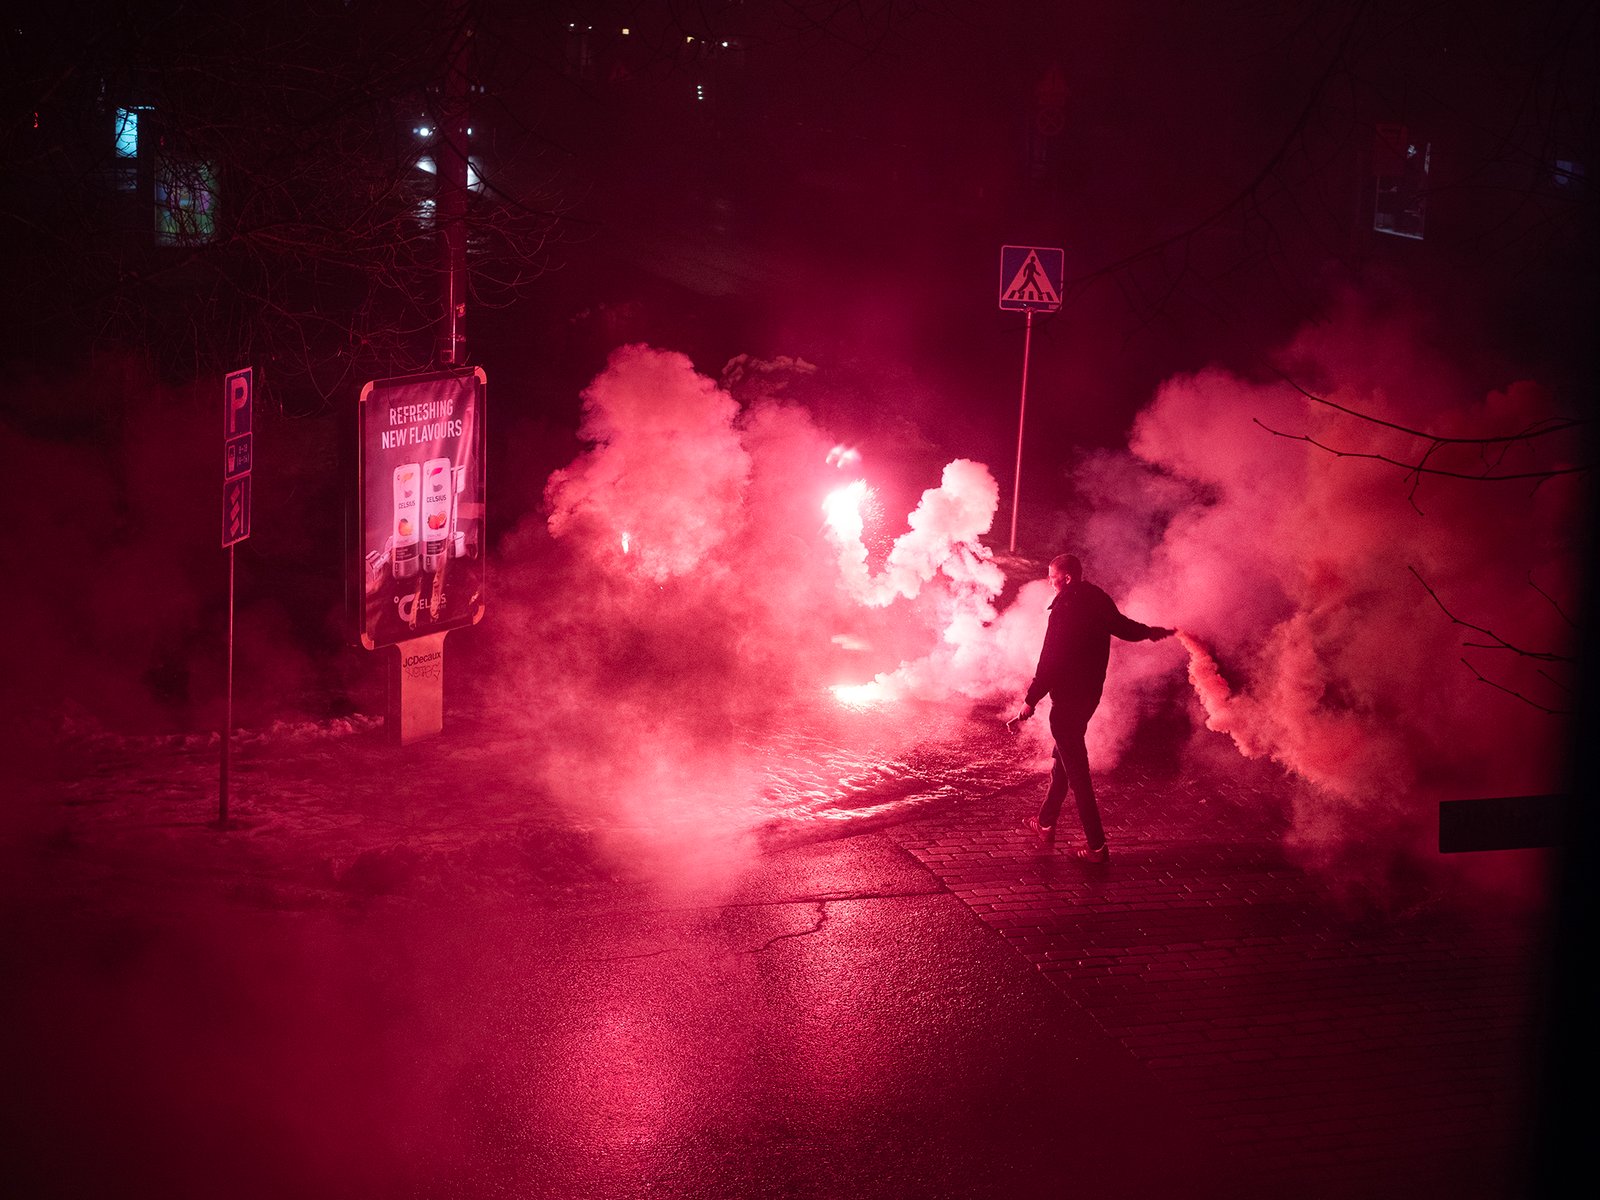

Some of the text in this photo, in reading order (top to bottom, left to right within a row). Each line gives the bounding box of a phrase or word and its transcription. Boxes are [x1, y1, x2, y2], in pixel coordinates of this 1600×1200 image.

[230, 377, 248, 433] P
[390, 399, 453, 426] REFRESHING
[381, 419, 462, 449] NEW FLAVOURS
[398, 500, 416, 509] CELSIUS
[426, 494, 447, 503] CELSIUS
[403, 651, 441, 668] JCDecaux
